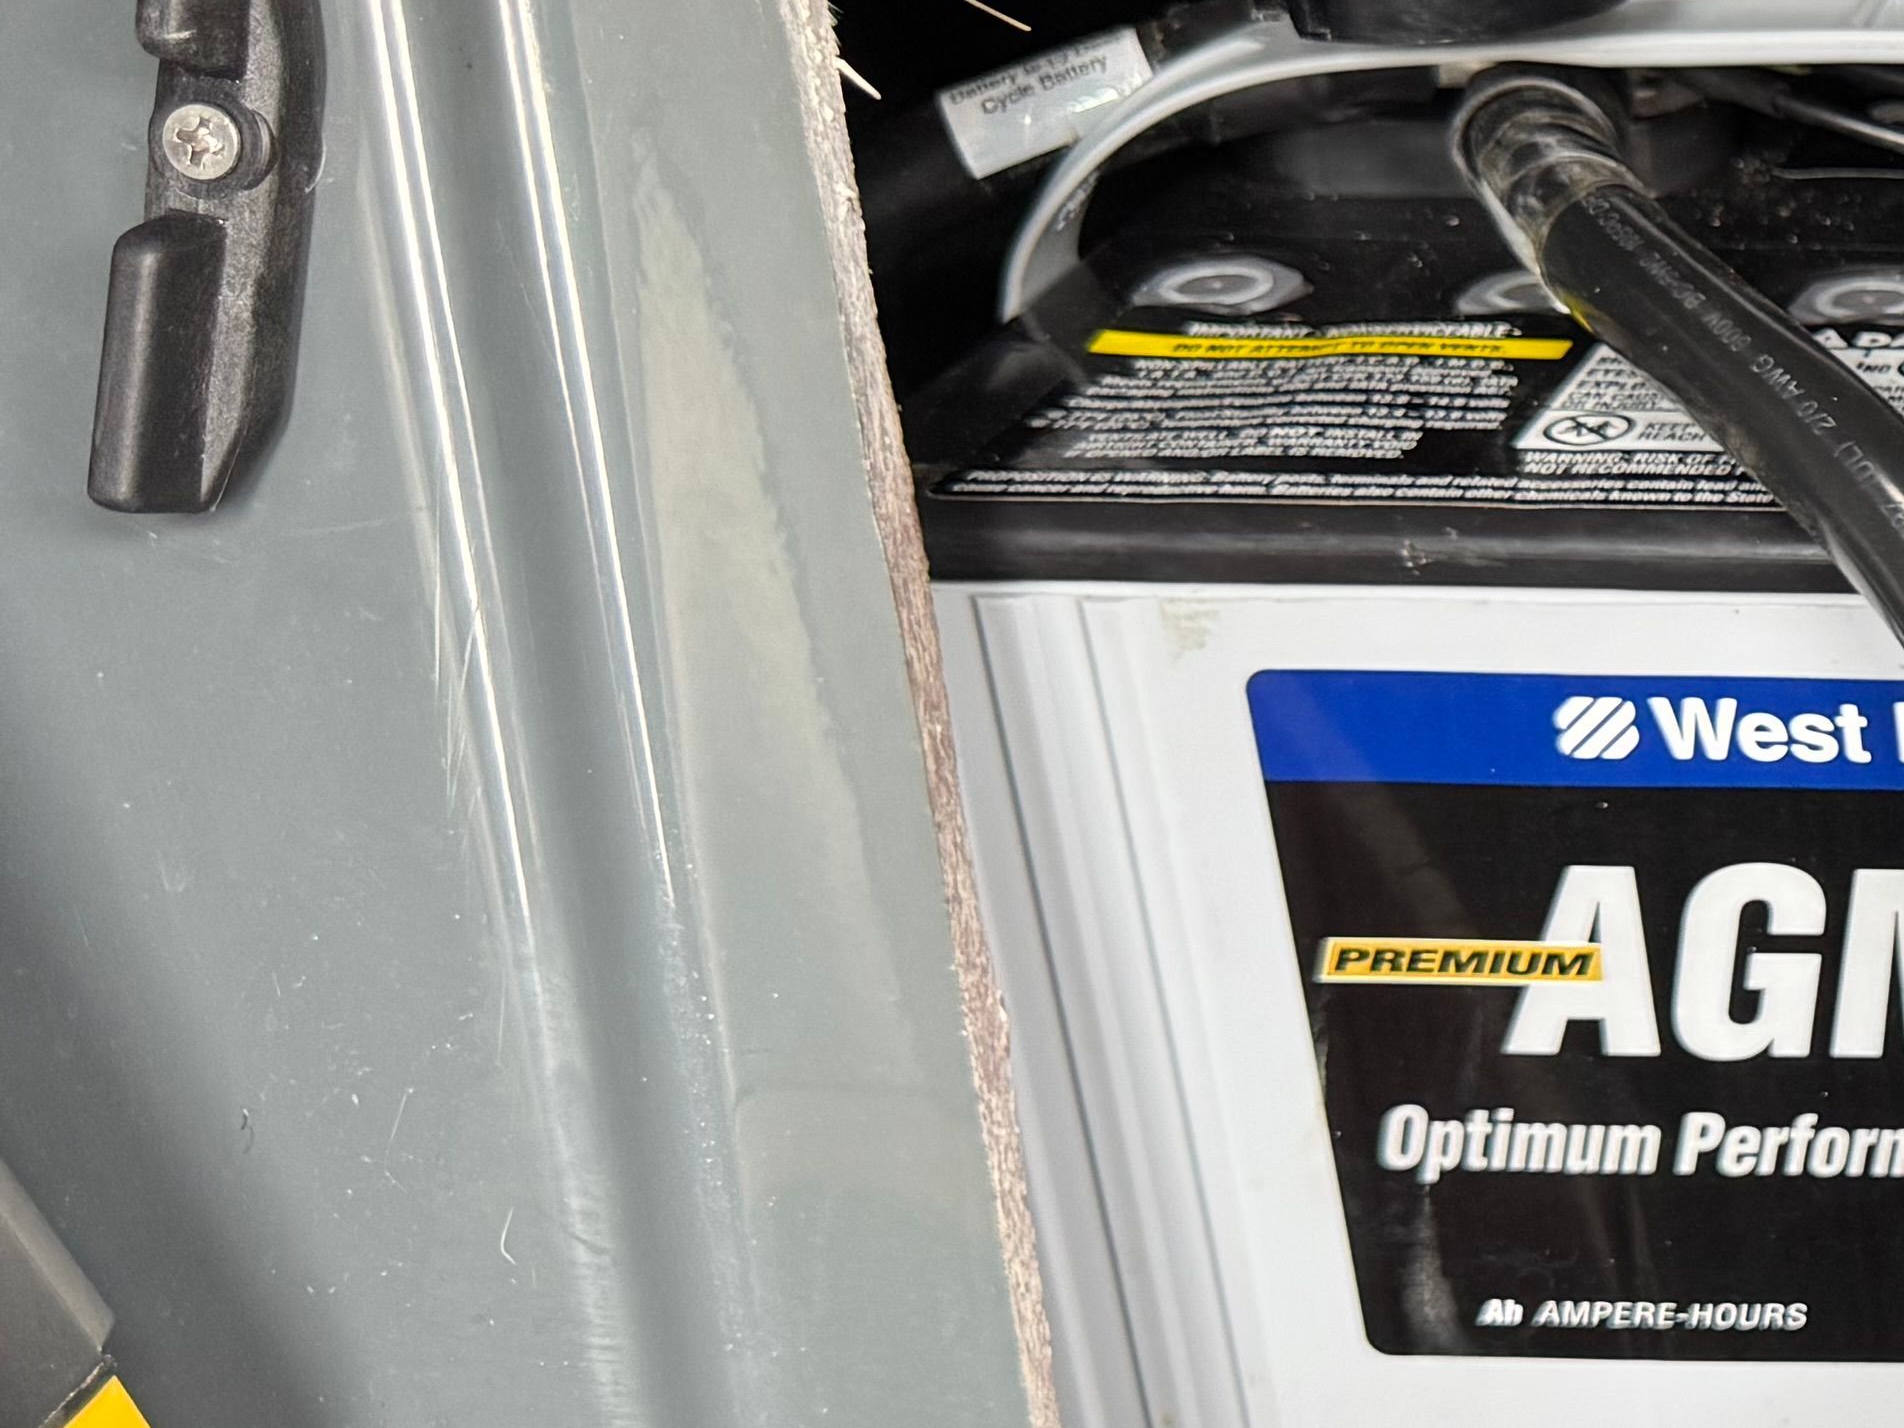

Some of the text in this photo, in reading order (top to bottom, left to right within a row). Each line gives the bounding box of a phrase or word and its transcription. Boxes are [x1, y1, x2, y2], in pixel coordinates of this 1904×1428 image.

[1751, 354, 1803, 401] AWG
[1525, 463, 1732, 476] NOT RECOMMENDED
[1634, 452, 1683, 464] RISK
[1650, 697, 1872, 764] West
[1334, 946, 1595, 979] PREMIUM
[1381, 1105, 1662, 1183] Optimum
[1478, 1298, 1809, 1331] Ah AMPERE-HOURS
